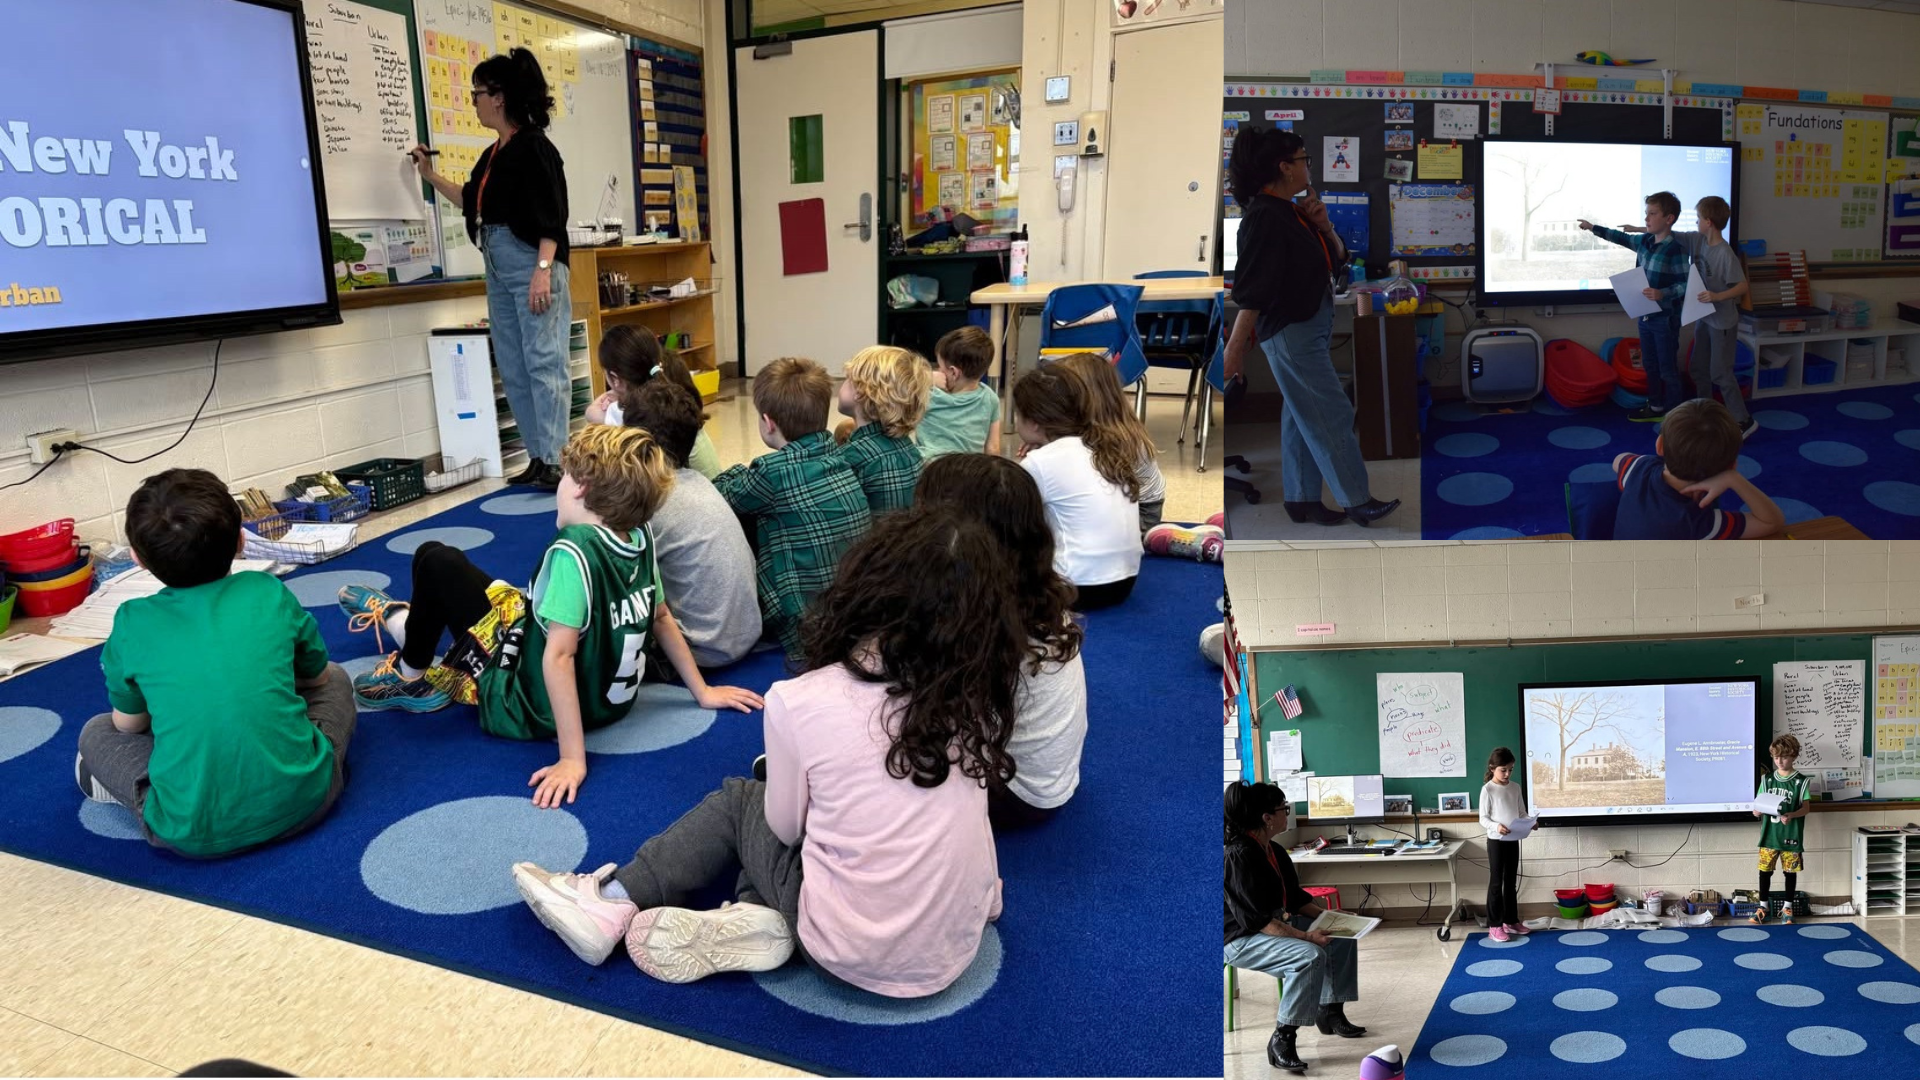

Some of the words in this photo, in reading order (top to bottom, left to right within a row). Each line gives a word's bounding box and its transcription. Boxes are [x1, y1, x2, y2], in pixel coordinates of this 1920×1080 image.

[1768, 112, 1843, 130] Fundations
[0, 120, 112, 175] New
[124, 129, 238, 181] York
[0, 196, 207, 248] ORICAL
[606, 631, 646, 704] 5
[1393, 683, 1403, 692] who
[1435, 701, 1451, 713] what
[1407, 725, 1439, 740] predicate
[1426, 746, 1438, 754] they
[1441, 740, 1451, 749] did
